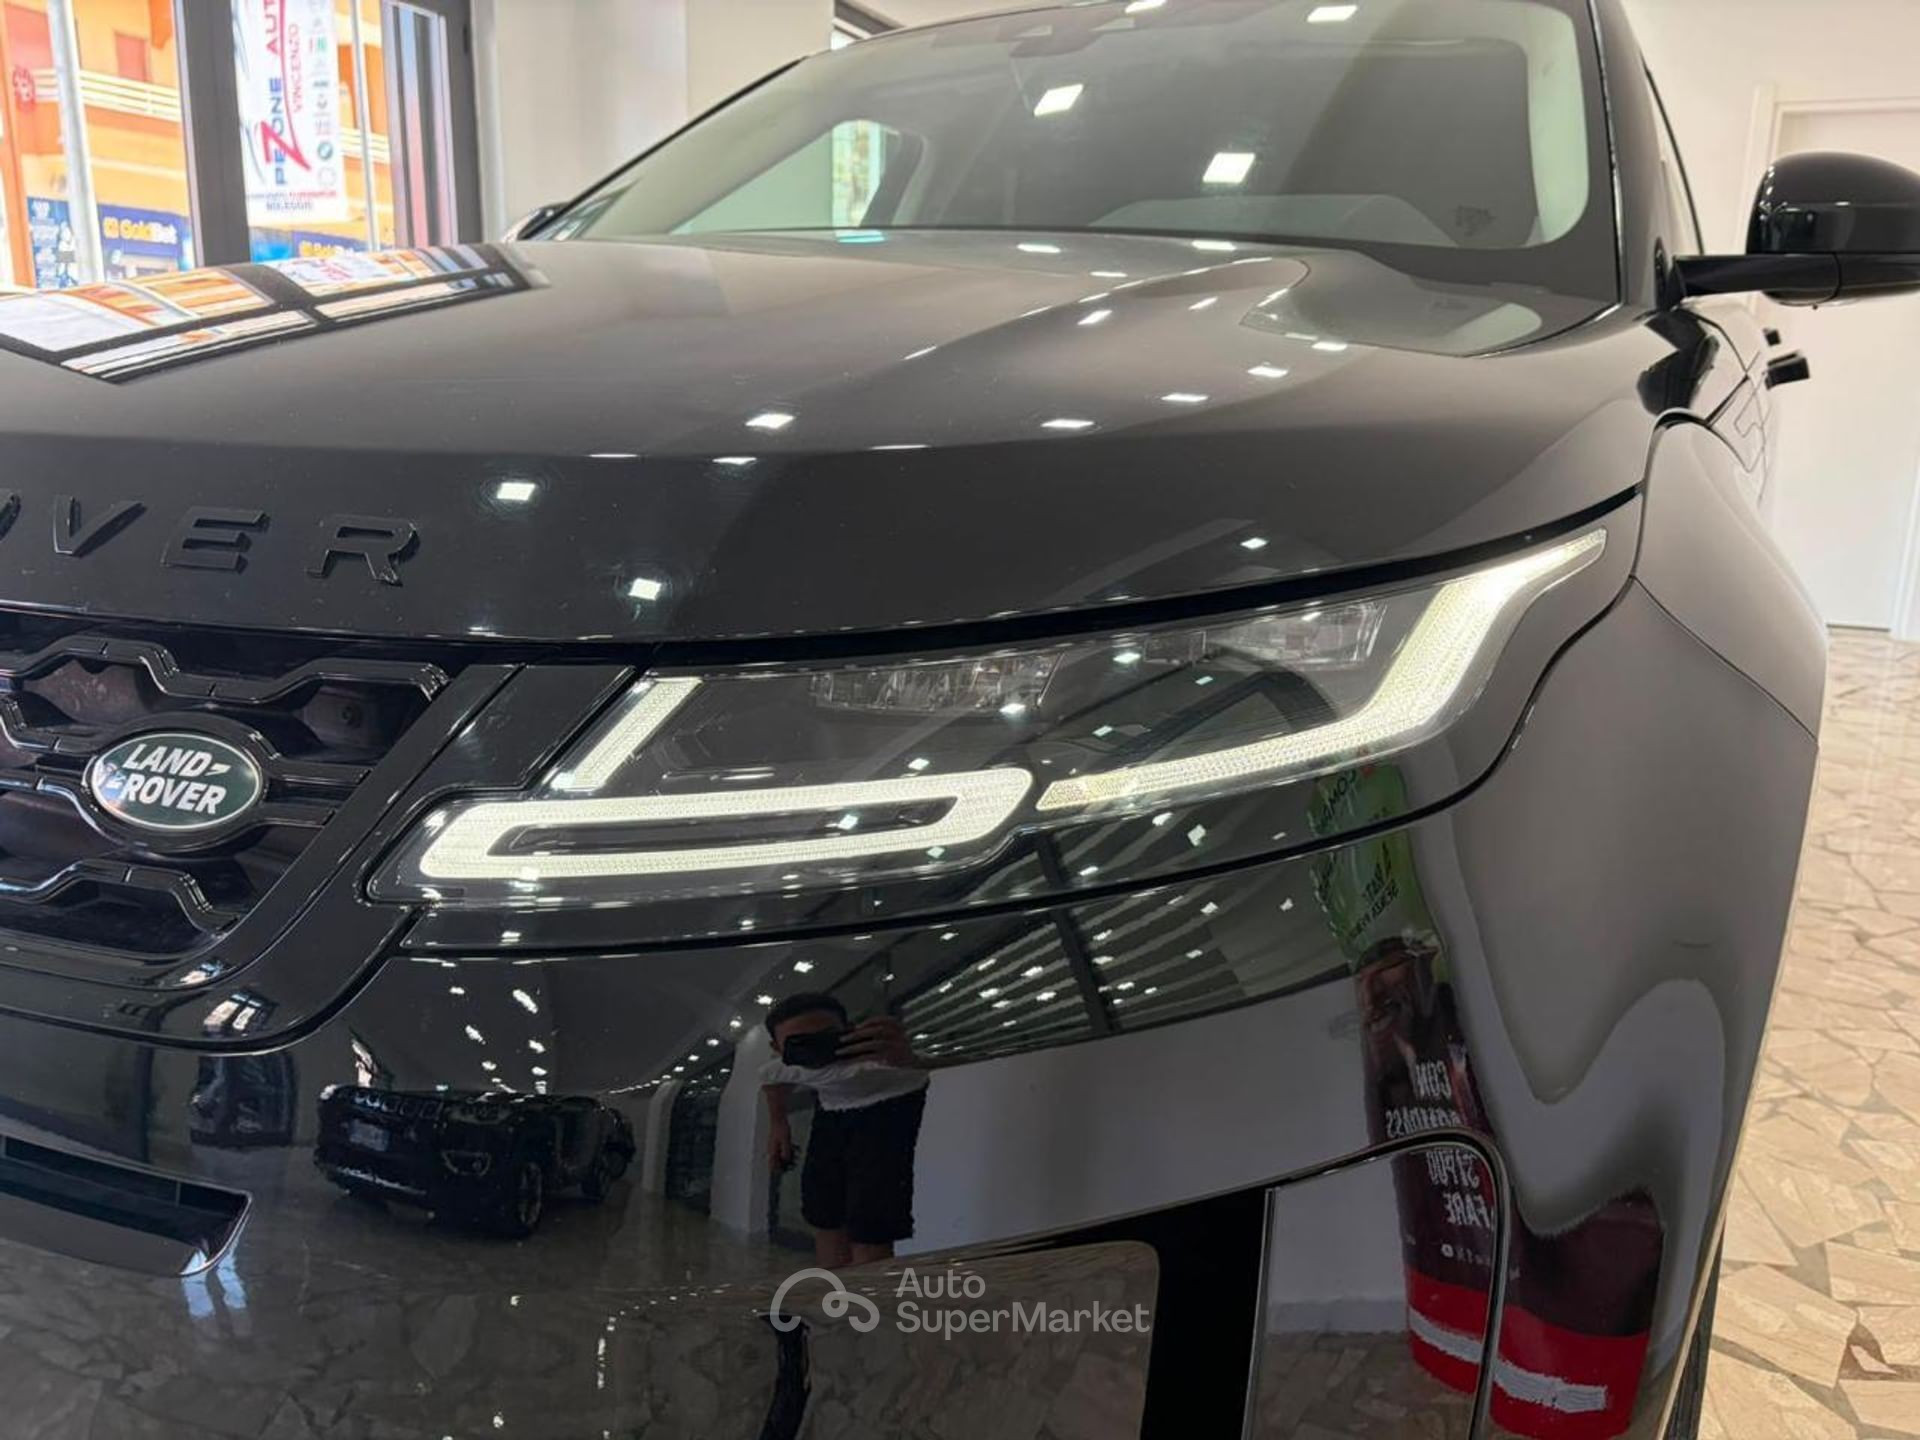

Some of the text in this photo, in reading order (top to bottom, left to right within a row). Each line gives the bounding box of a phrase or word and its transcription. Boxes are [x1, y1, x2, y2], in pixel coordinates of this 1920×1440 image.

[288, 23, 303, 112] VINCENZO
[0, 489, 420, 587] VER
[117, 773, 227, 814] ROVER
